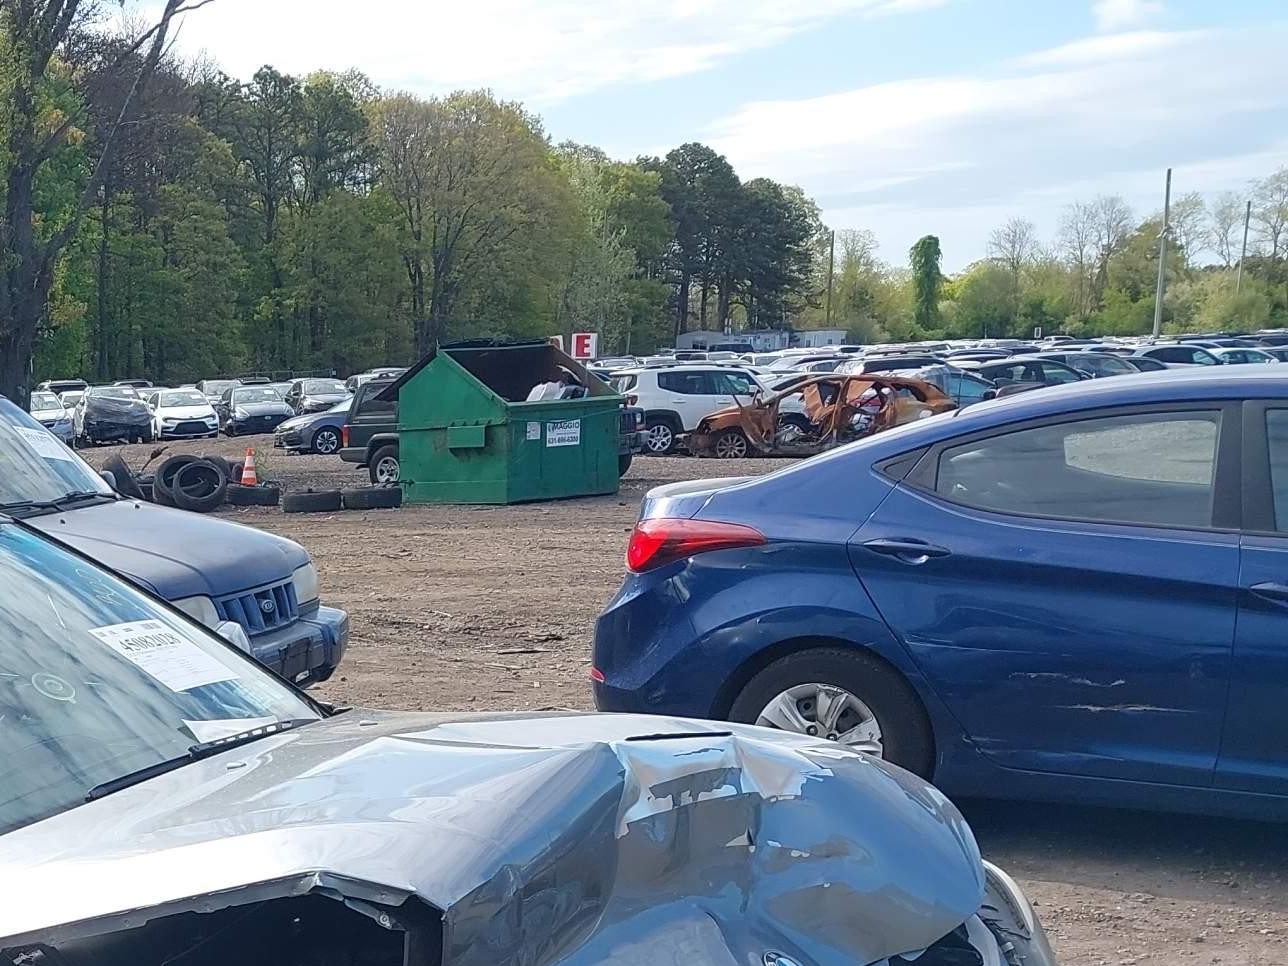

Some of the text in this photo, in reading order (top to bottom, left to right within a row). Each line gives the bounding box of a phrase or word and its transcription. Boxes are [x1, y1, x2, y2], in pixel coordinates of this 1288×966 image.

[575, 335, 591, 357] E
[553, 421, 580, 432] MAGGIO
[118, 632, 183, 652] 45082028
